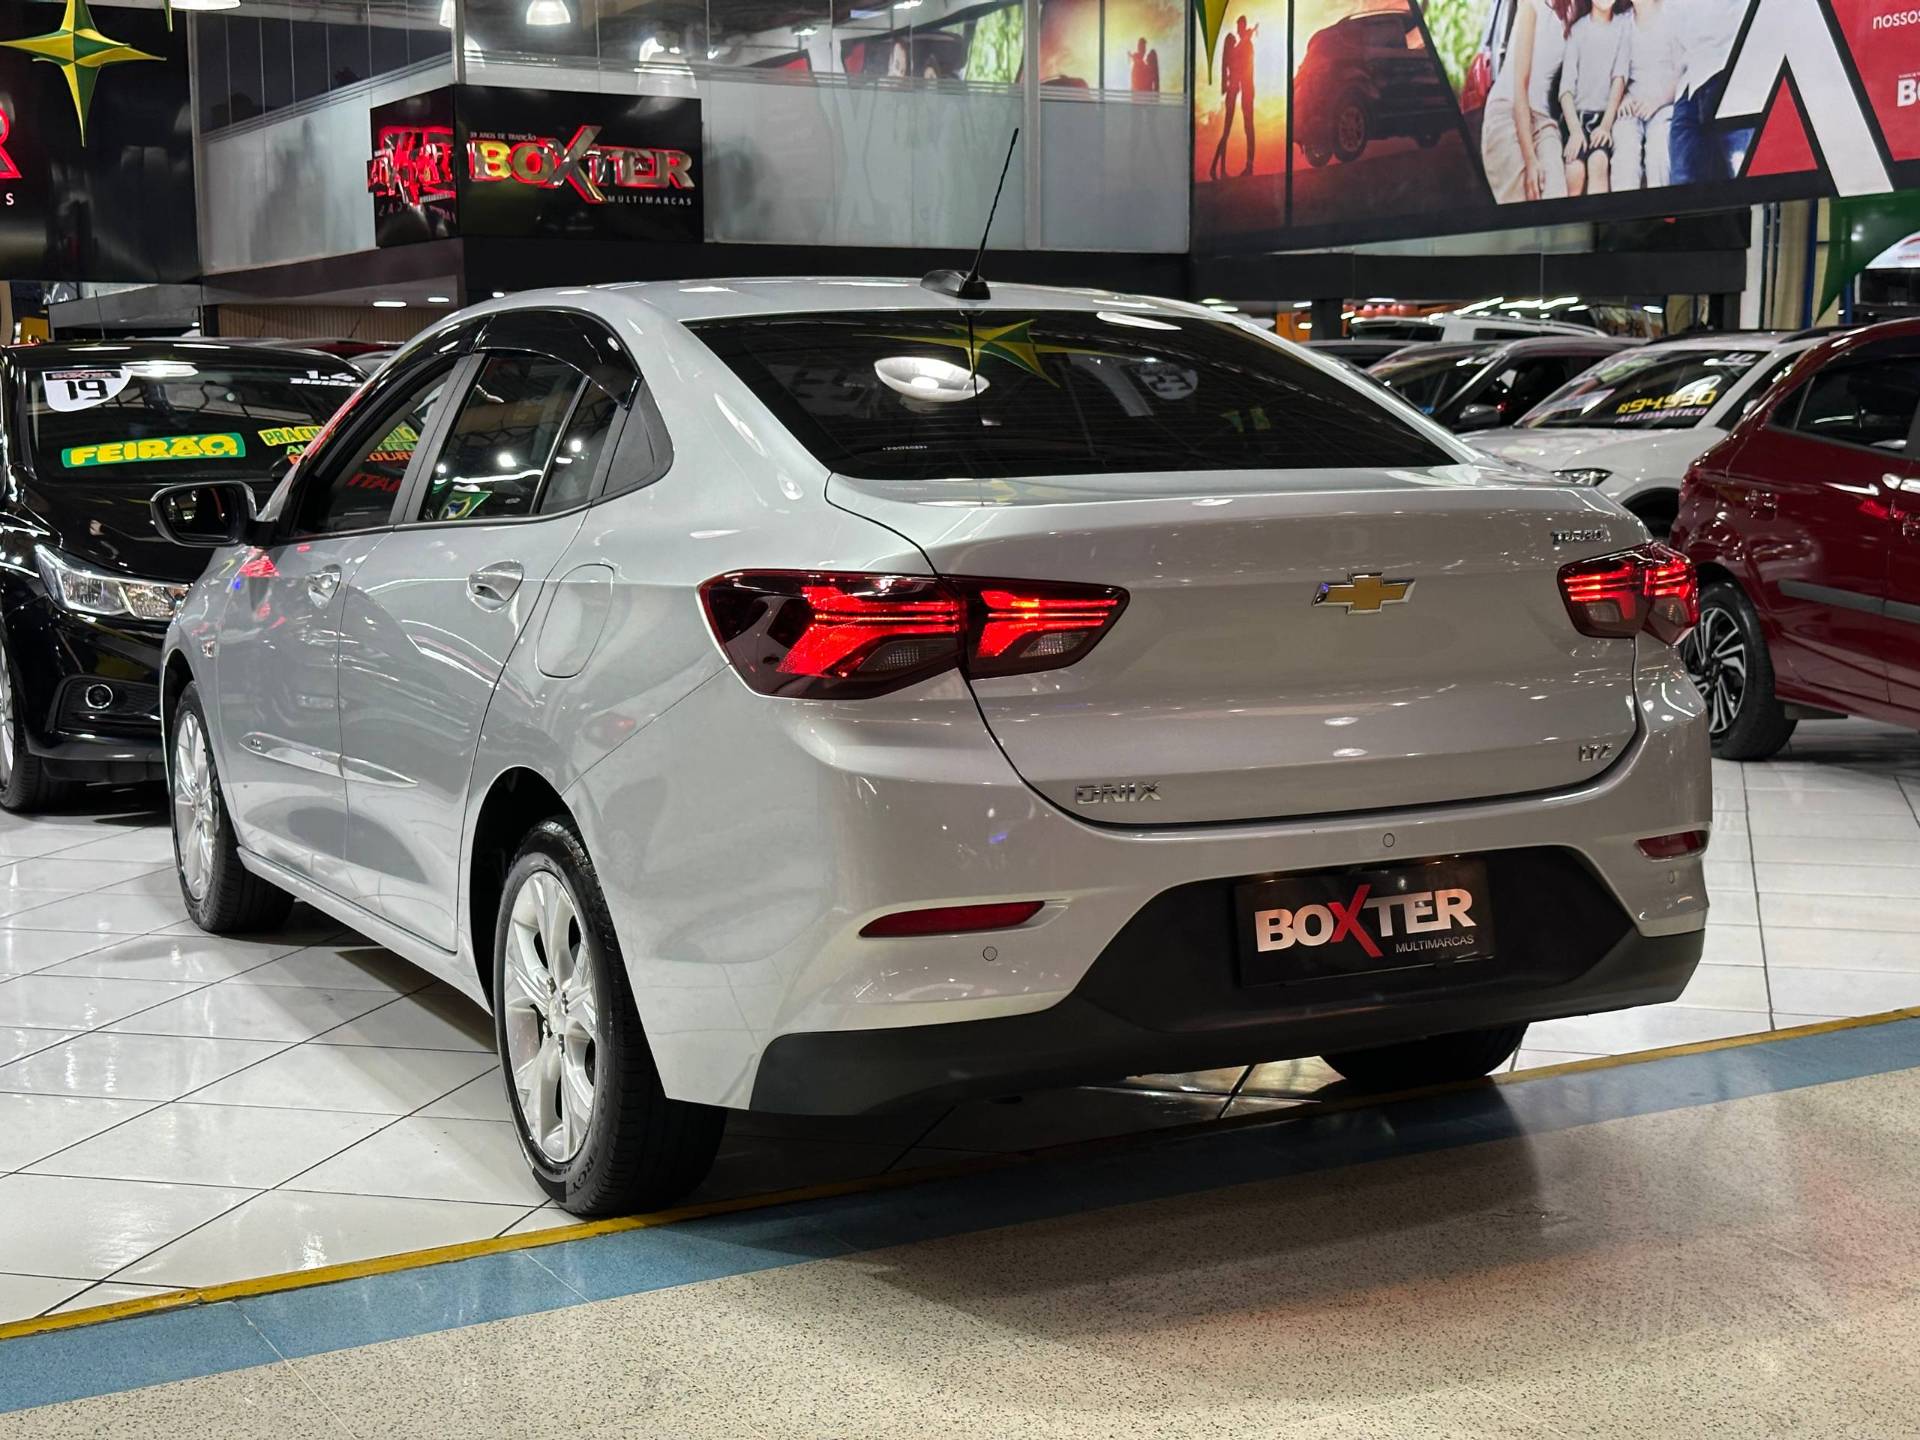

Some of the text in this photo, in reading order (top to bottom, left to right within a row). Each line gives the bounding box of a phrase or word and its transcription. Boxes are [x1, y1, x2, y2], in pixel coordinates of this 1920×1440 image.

[1897, 77, 1920, 107] B
[466, 125, 696, 205] BOXTER
[607, 194, 692, 206] MULTIMARCAS
[65, 379, 110, 401] 19
[69, 434, 239, 466] FEIRÃO
[1578, 743, 1613, 762] LTZ
[1076, 781, 1161, 805] ONIX
[1254, 884, 1477, 958] BOXTER
[1395, 935, 1475, 953] MULTIMARCAS
